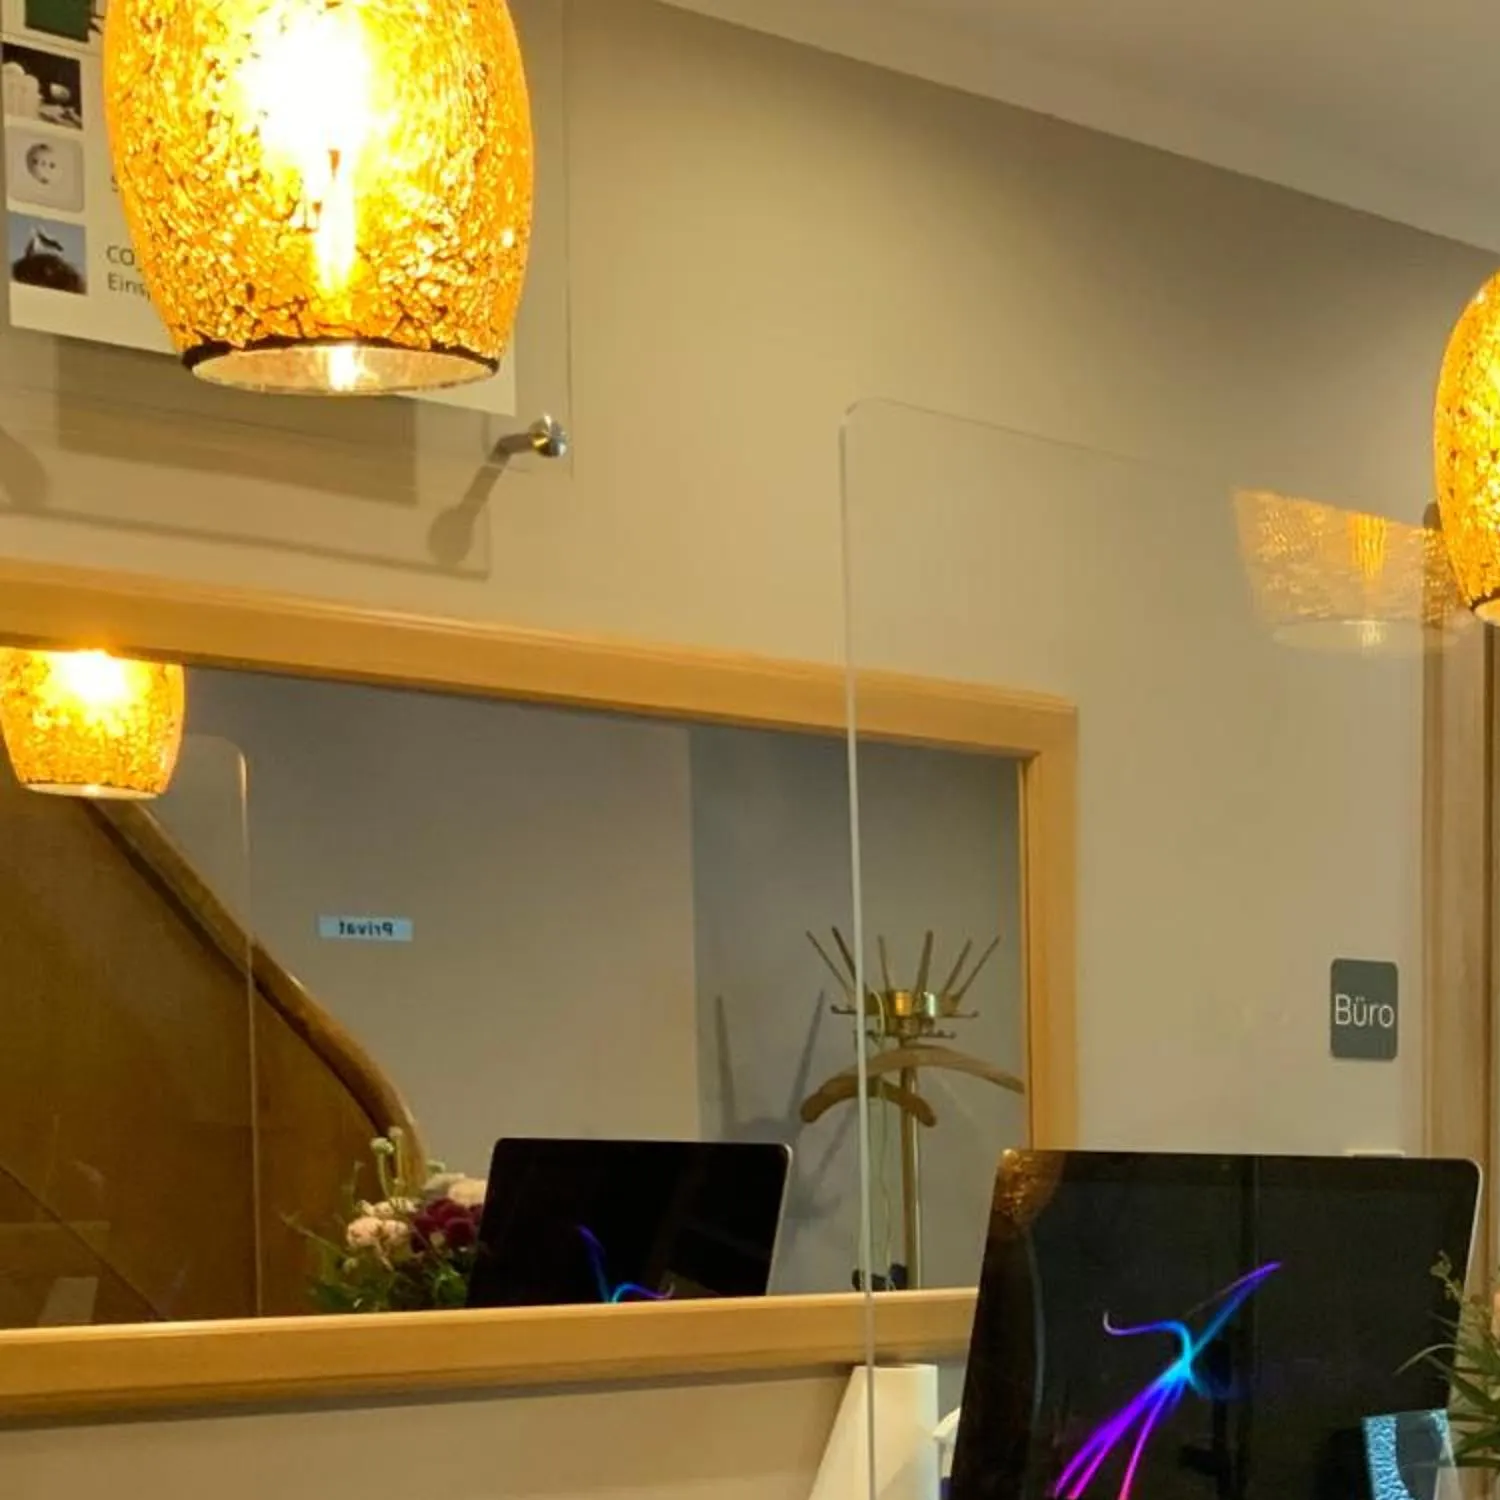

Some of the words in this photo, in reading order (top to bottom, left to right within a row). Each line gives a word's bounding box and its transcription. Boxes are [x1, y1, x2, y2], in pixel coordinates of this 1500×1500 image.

[106, 244, 142, 273] CO
[107, 271, 151, 303] Eins
[1335, 993, 1395, 1028] Büro
